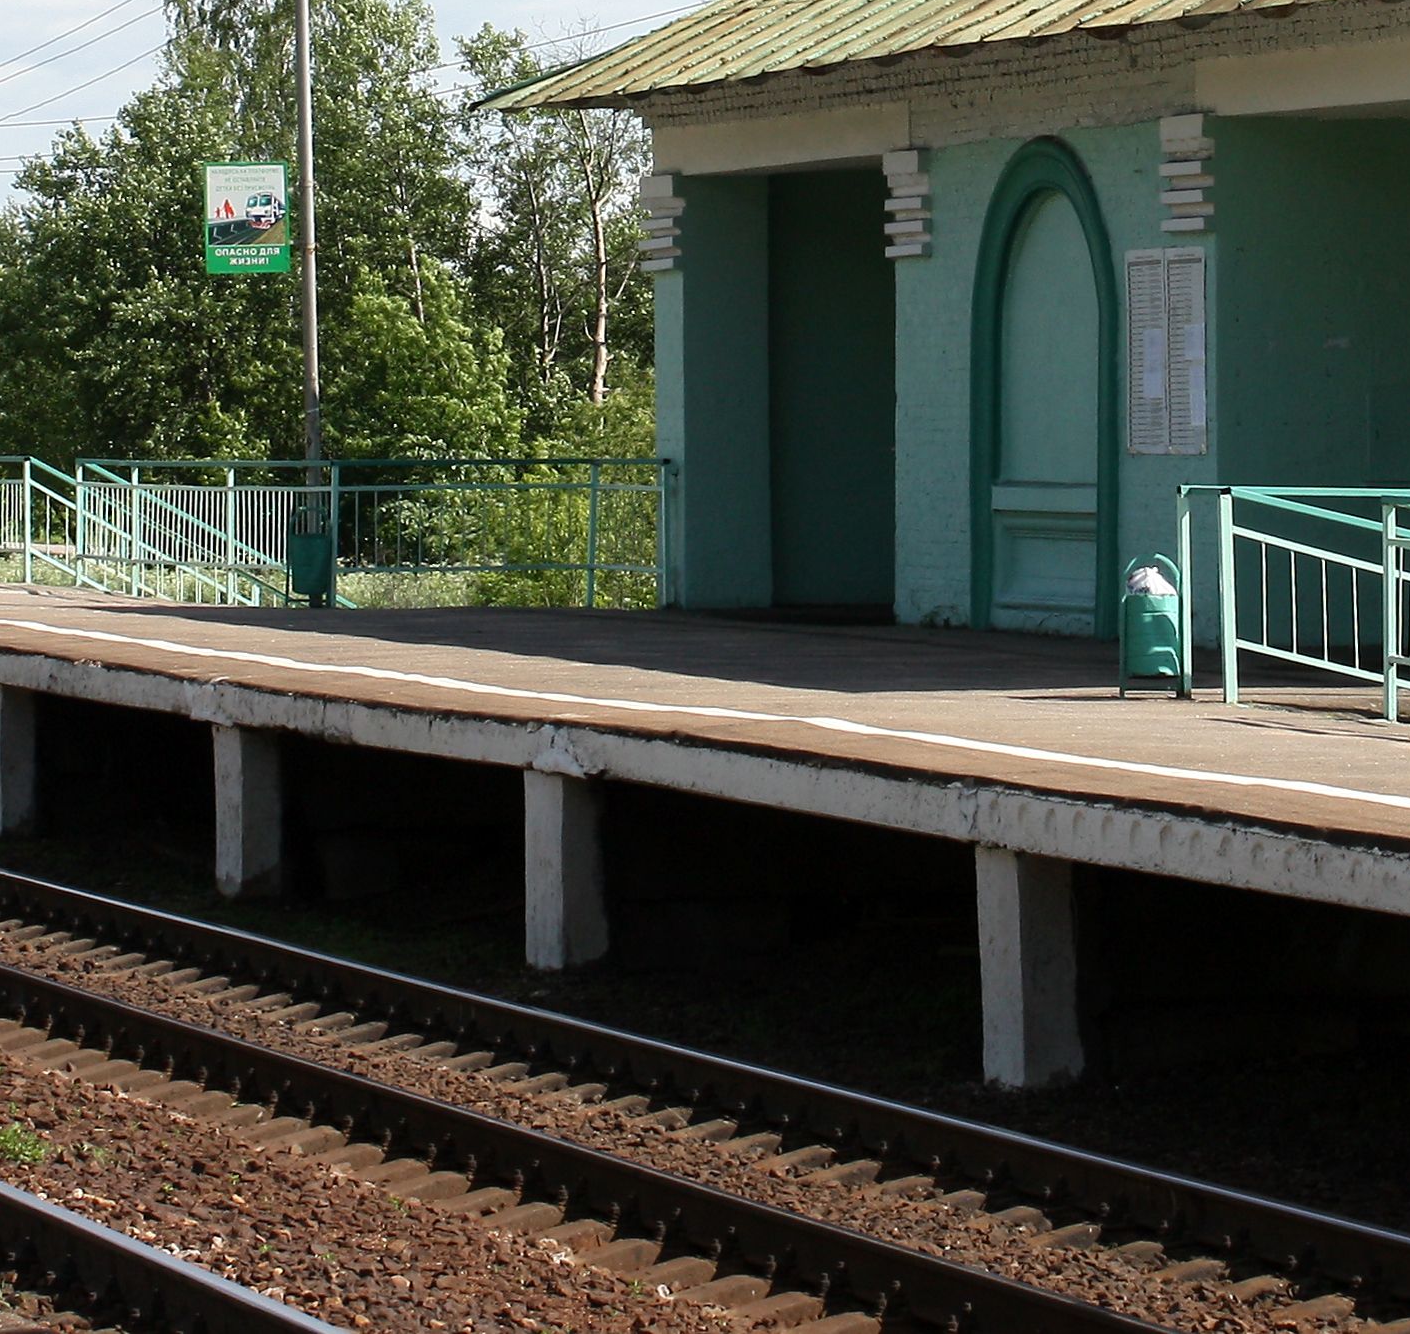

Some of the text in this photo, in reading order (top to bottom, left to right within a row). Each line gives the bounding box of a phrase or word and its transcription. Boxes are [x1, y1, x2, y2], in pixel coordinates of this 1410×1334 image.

[214, 247, 280, 257] ОПАСНО ДЛЯ
[229, 257, 269, 265] ЖИЗНИ!
